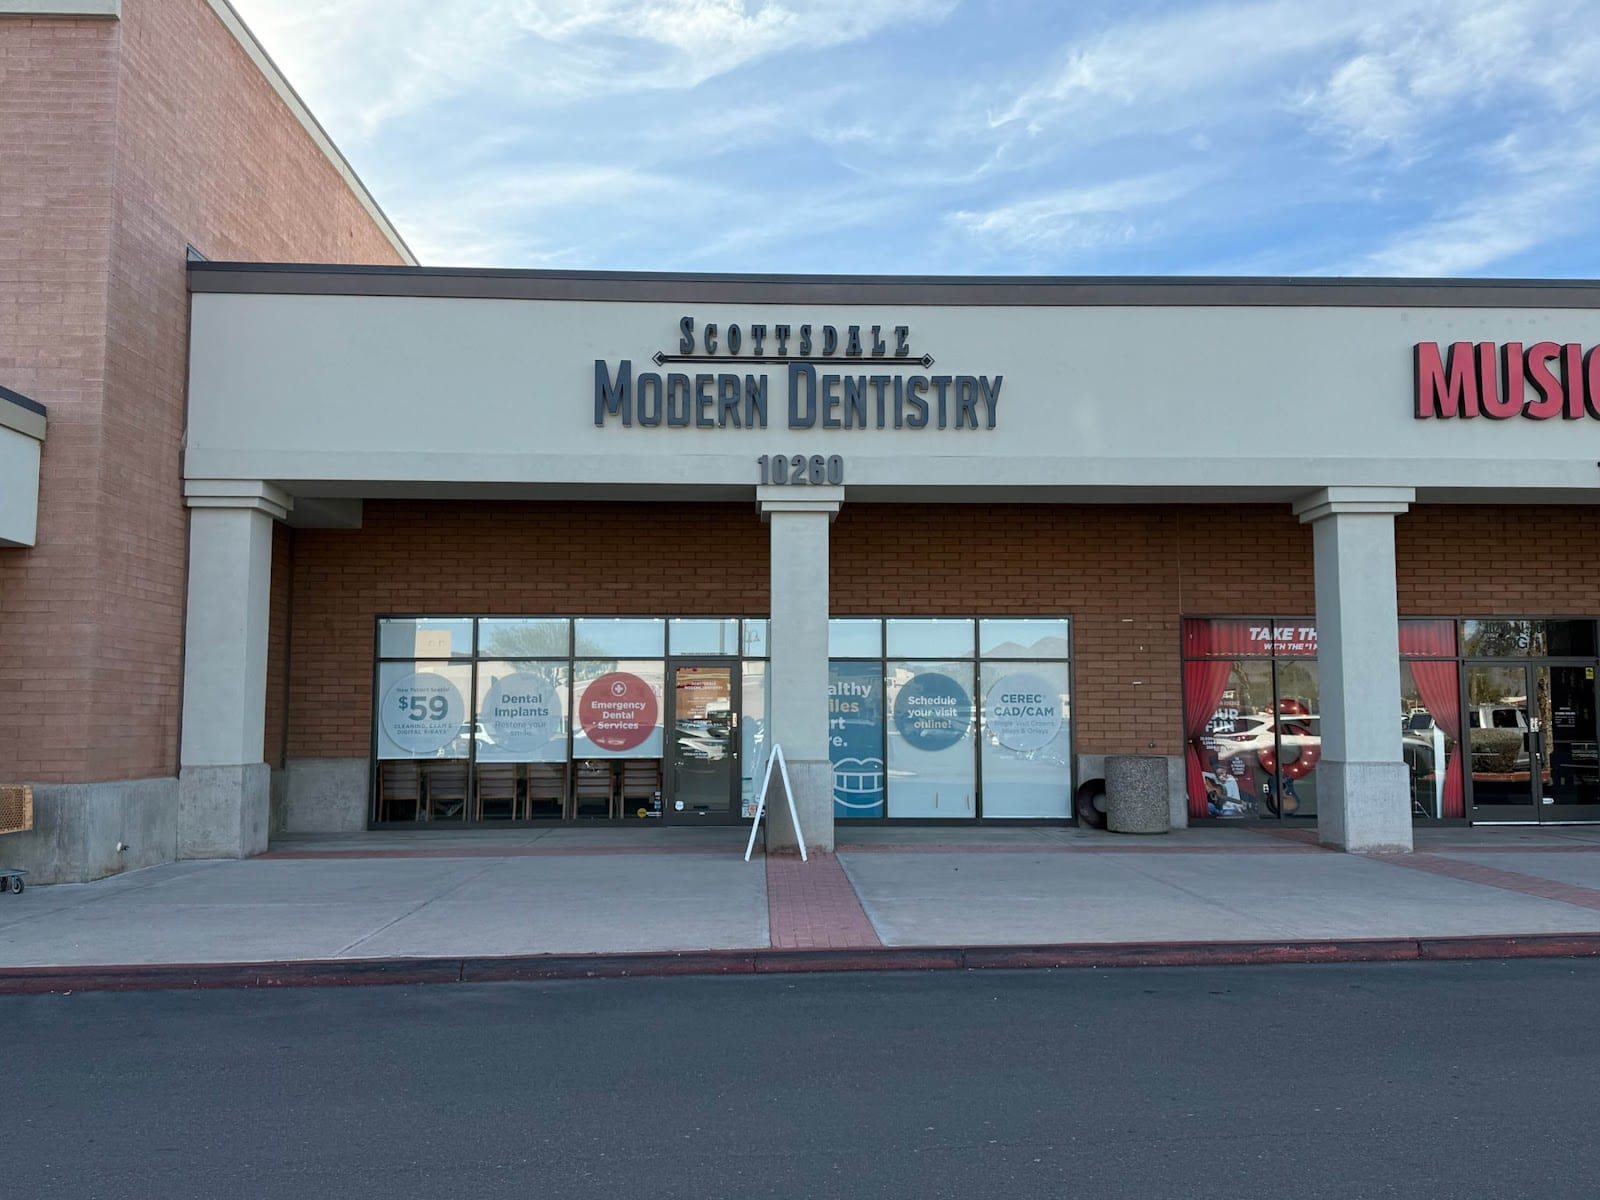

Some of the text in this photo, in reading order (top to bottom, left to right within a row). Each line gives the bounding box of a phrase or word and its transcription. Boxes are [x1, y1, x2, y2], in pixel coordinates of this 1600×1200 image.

[680, 316, 910, 356] SCOTTSDALE
[594, 359, 1003, 430] MODERN DENTISTRY
[757, 454, 845, 485] 10260
[1249, 627, 1295, 641] TAKE
[828, 682, 872, 698] althy
[501, 694, 542, 703] Dental
[907, 696, 957, 705] Schedule
[398, 695, 449, 721] $59
[591, 701, 646, 710] Emergency
[829, 699, 859, 713] iles
[495, 707, 549, 718] Implants
[603, 711, 634, 719] Dental
[907, 707, 958, 718] your visit
[994, 706, 1054, 718] CAD/CAM
[597, 722, 639, 730] Services
[913, 720, 952, 729] online!
